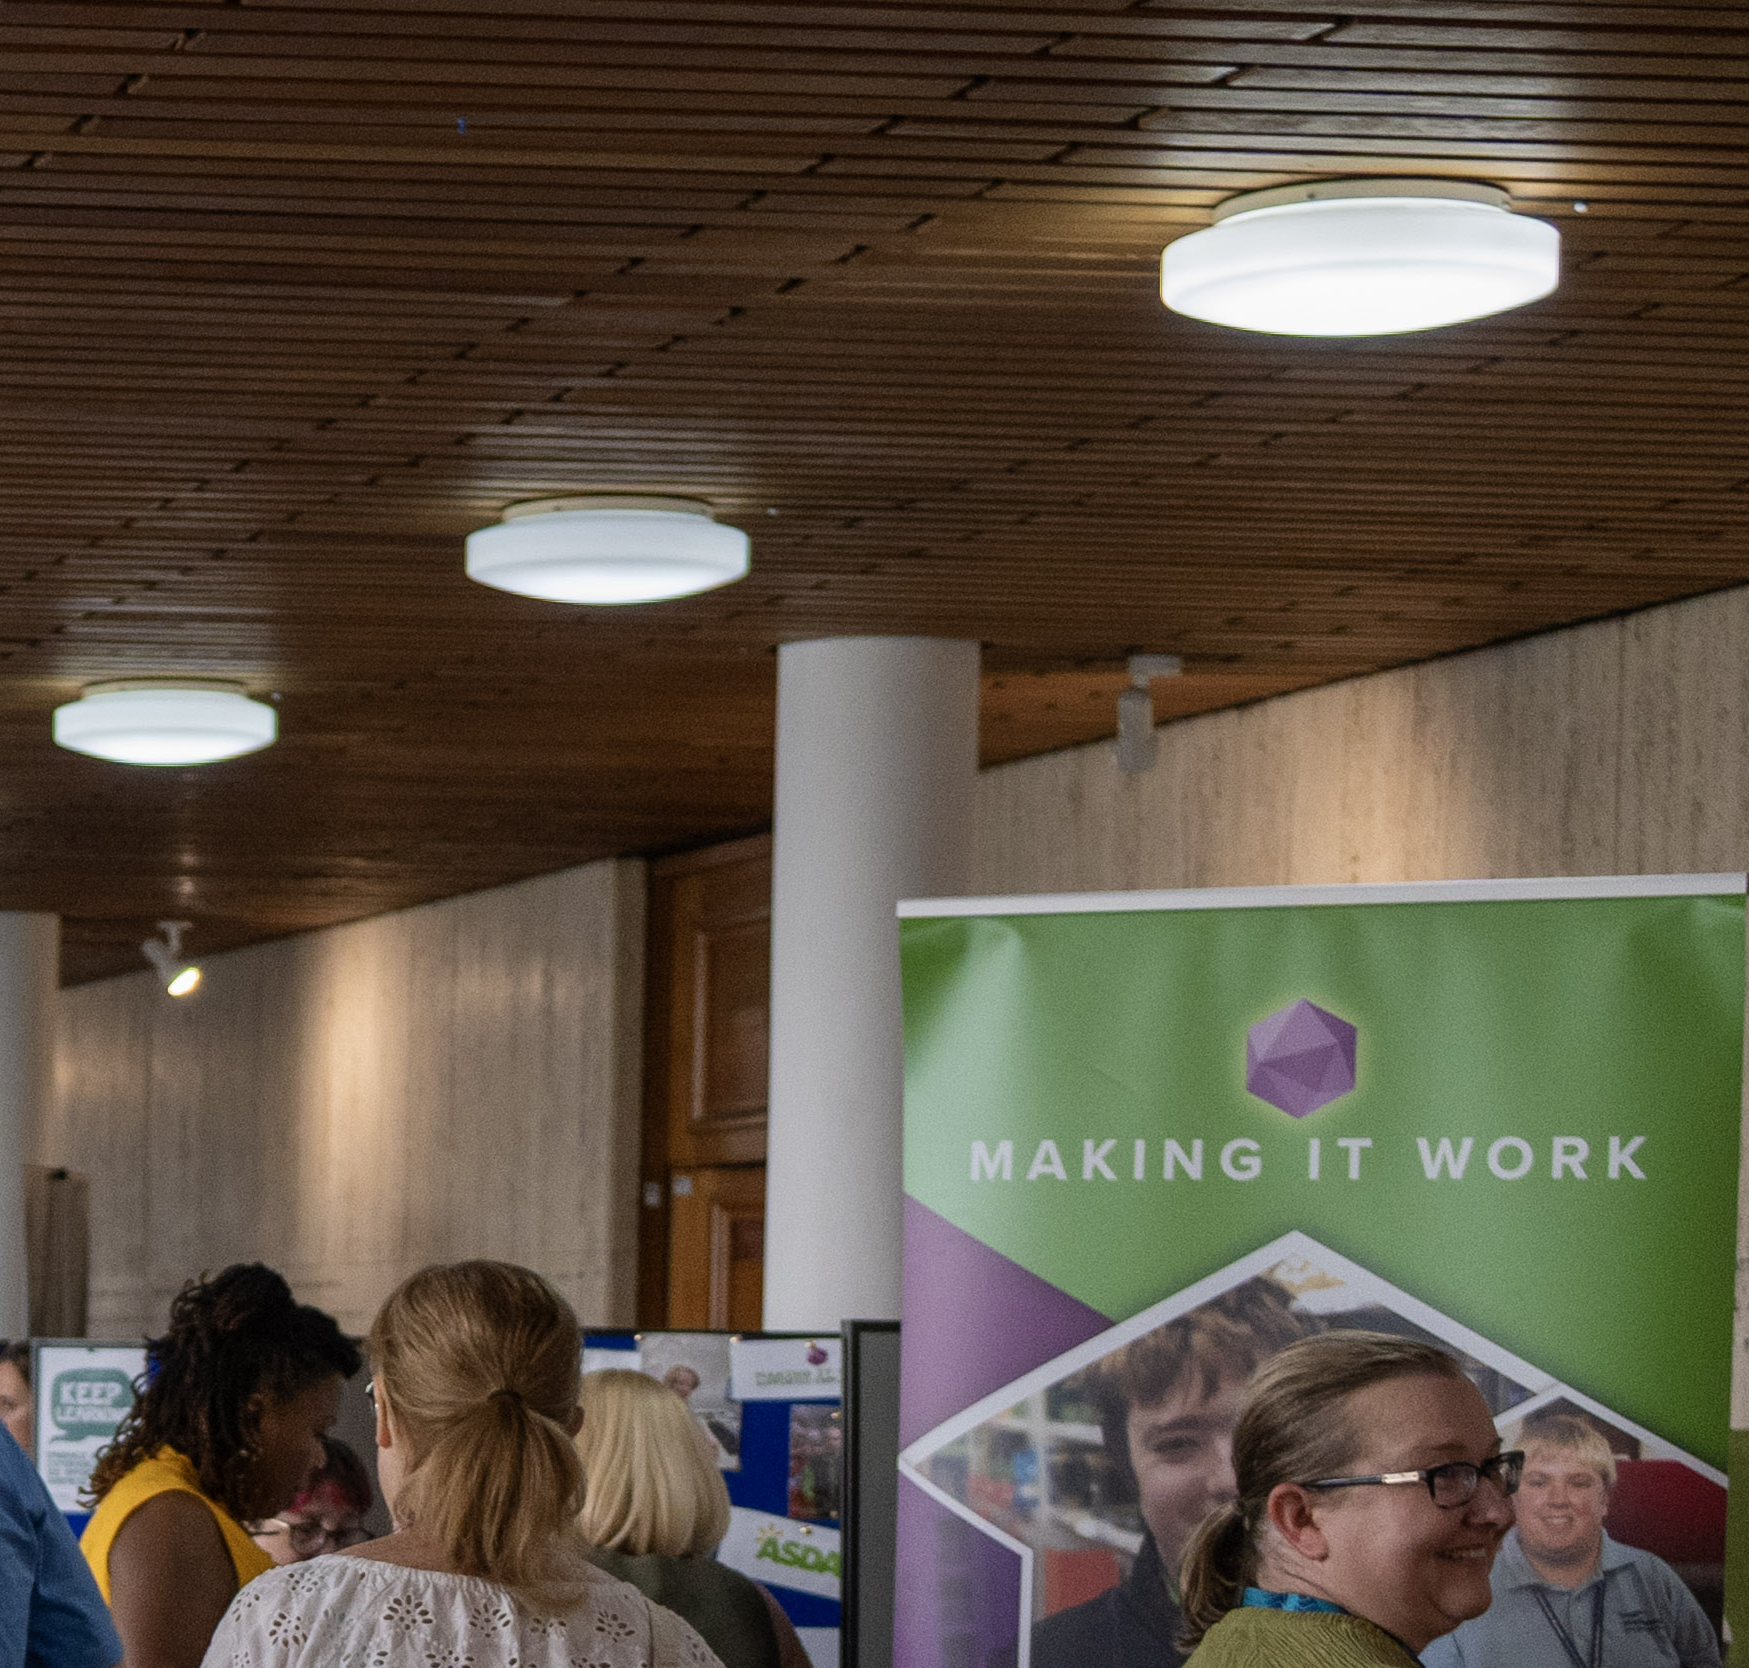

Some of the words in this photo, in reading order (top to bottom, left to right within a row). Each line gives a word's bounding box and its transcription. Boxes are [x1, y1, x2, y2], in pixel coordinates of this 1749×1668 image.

[969, 1138, 1263, 1182] MAKING
[1309, 1137, 1374, 1181] IT
[1415, 1134, 1648, 1181] WORK
[59, 1381, 125, 1405] KEEP
